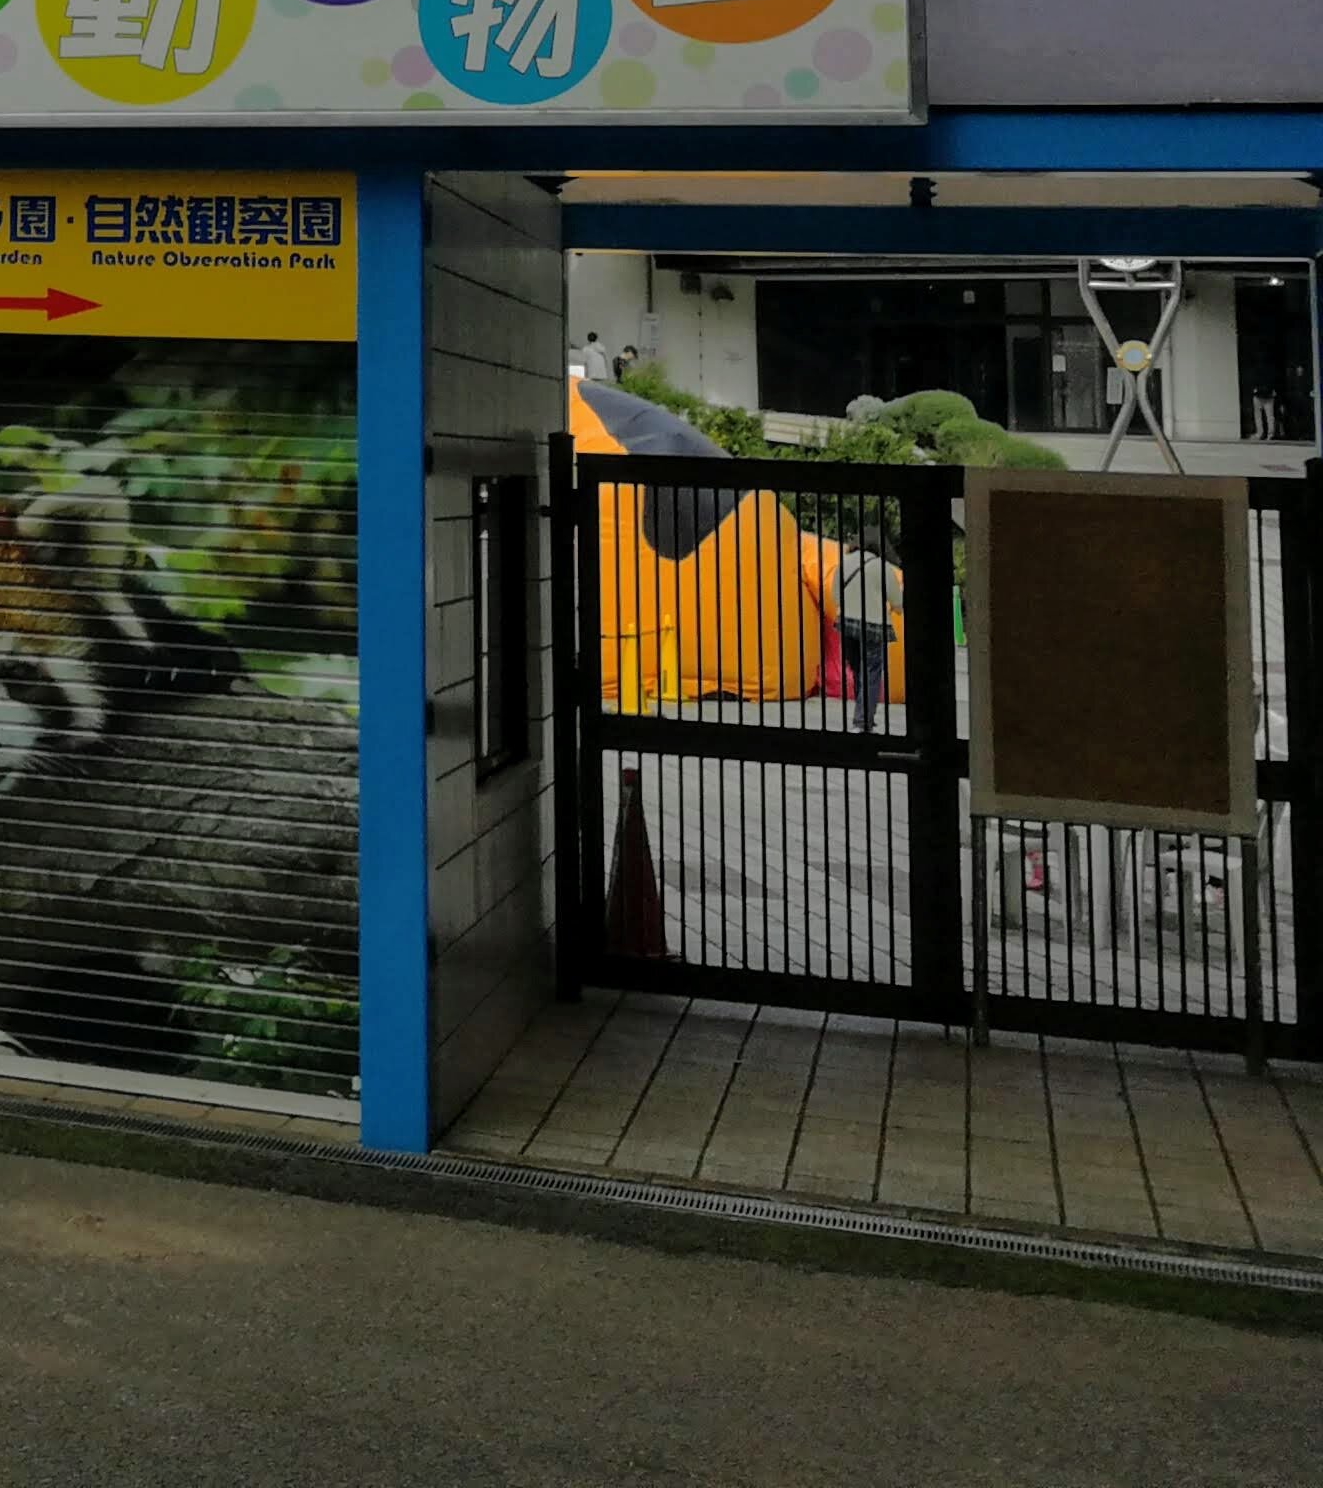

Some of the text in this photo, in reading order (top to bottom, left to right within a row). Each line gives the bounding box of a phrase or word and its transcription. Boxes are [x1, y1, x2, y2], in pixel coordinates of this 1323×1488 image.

[91, 250, 336, 270] Nature Observation Park
